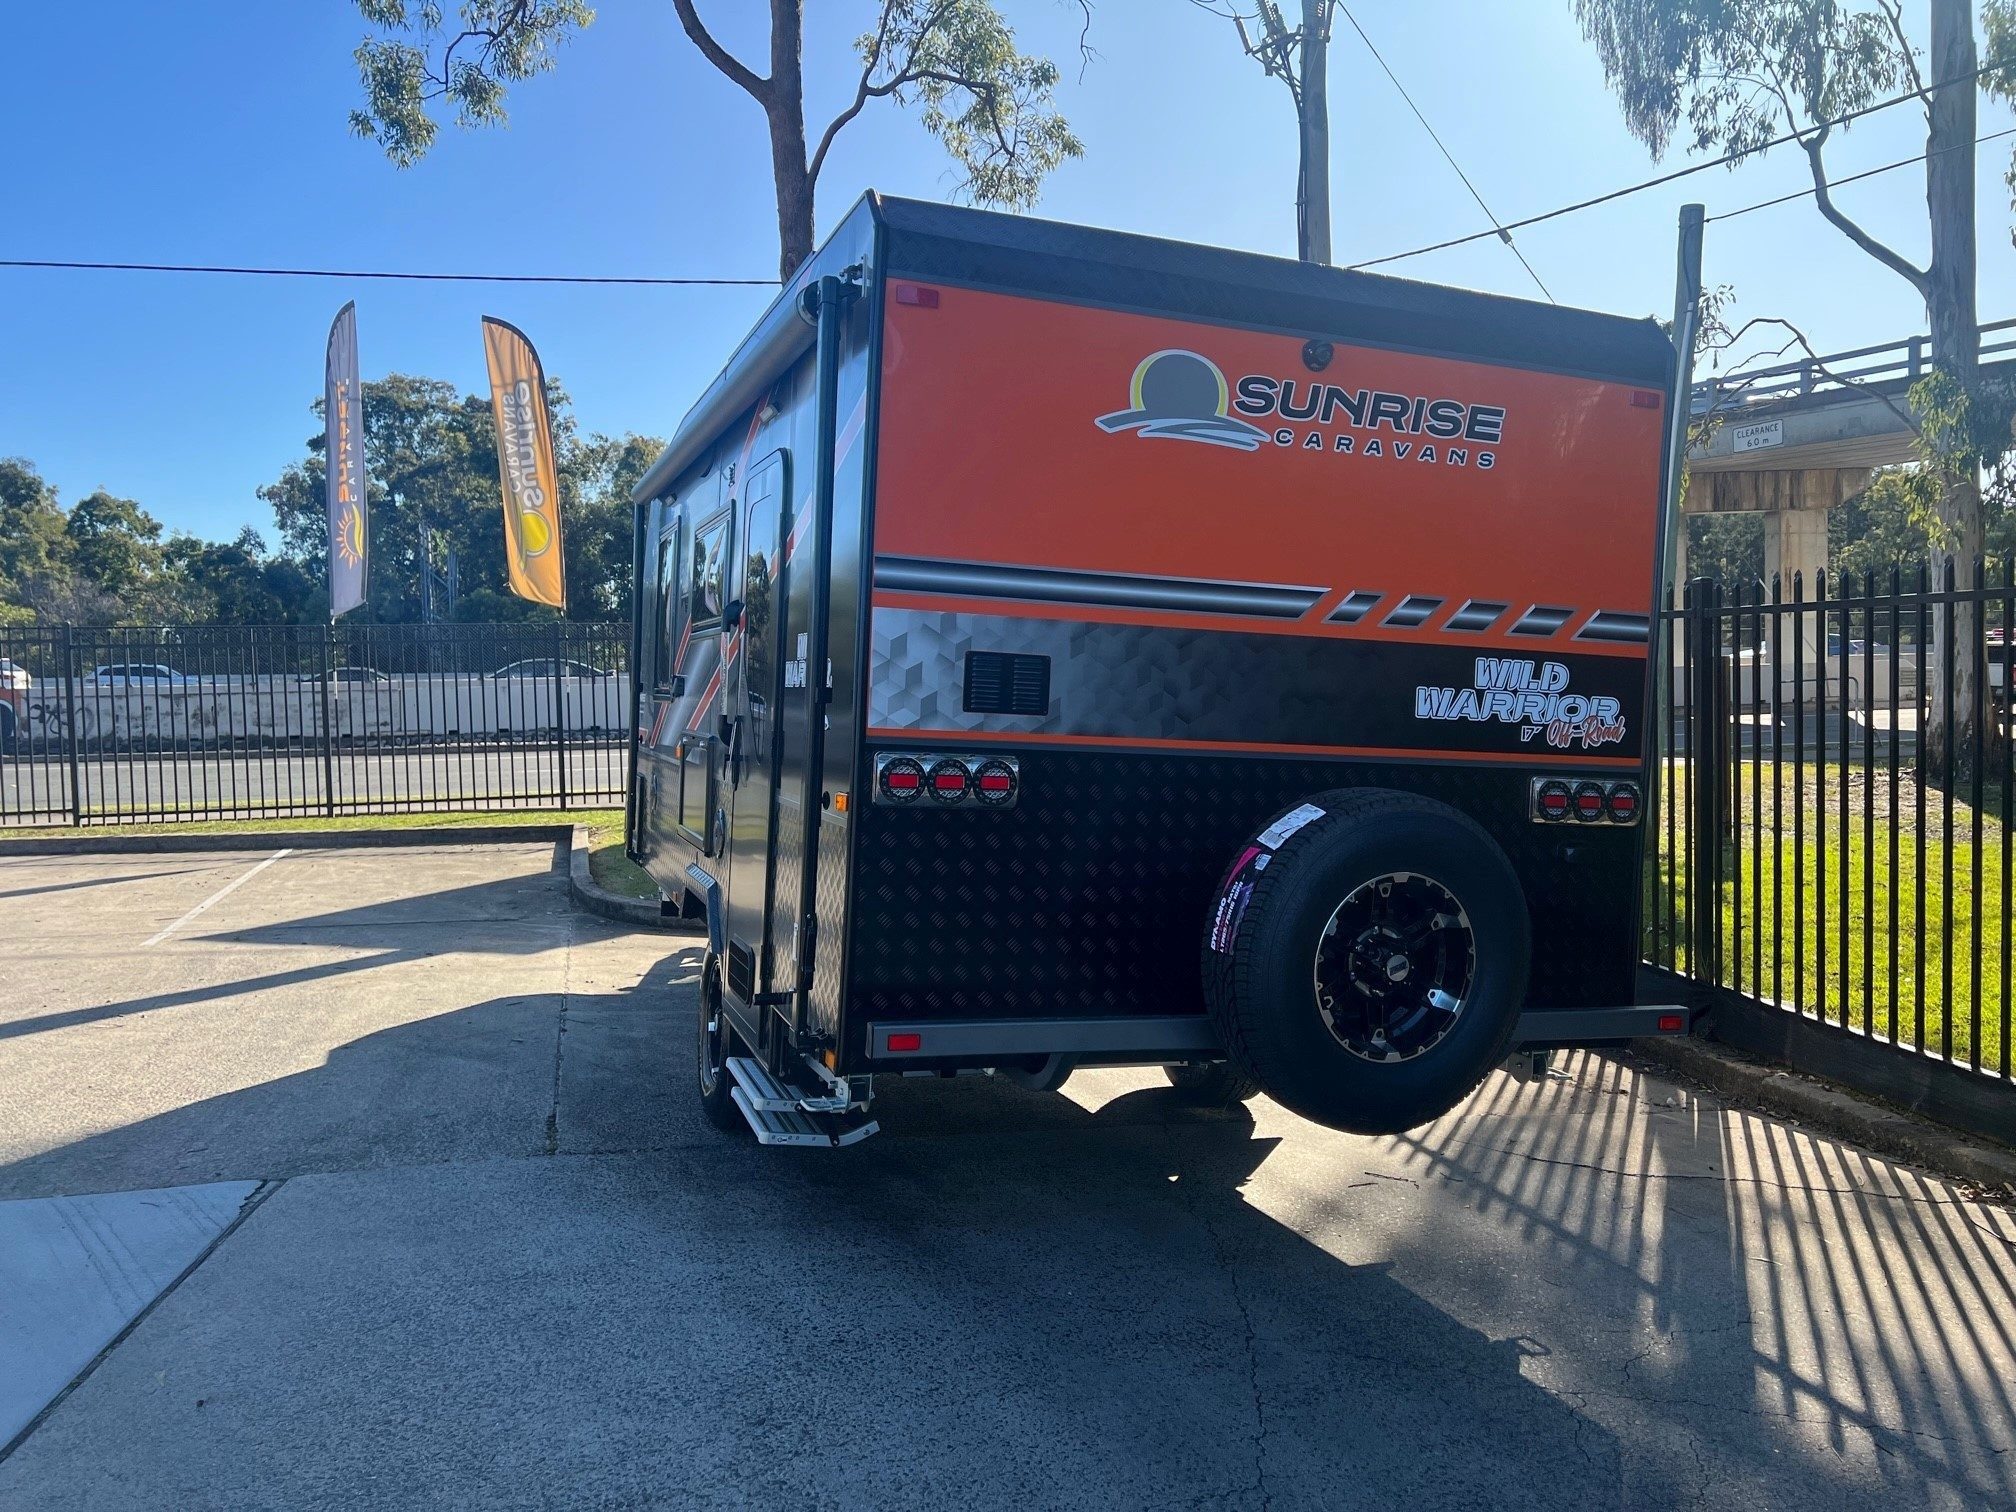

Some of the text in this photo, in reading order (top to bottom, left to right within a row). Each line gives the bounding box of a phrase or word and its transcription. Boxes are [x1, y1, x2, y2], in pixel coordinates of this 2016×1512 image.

[1234, 376, 1506, 444] SUNRISE
[1273, 428, 1496, 470] CARAVANS
[1736, 423, 1779, 439] CLEARANCE
[1475, 657, 1569, 693] WILD
[1415, 686, 1621, 726] WARRIOR
[1547, 715, 1626, 749] Off-Road
[1210, 897, 1227, 951] DYNAMO
